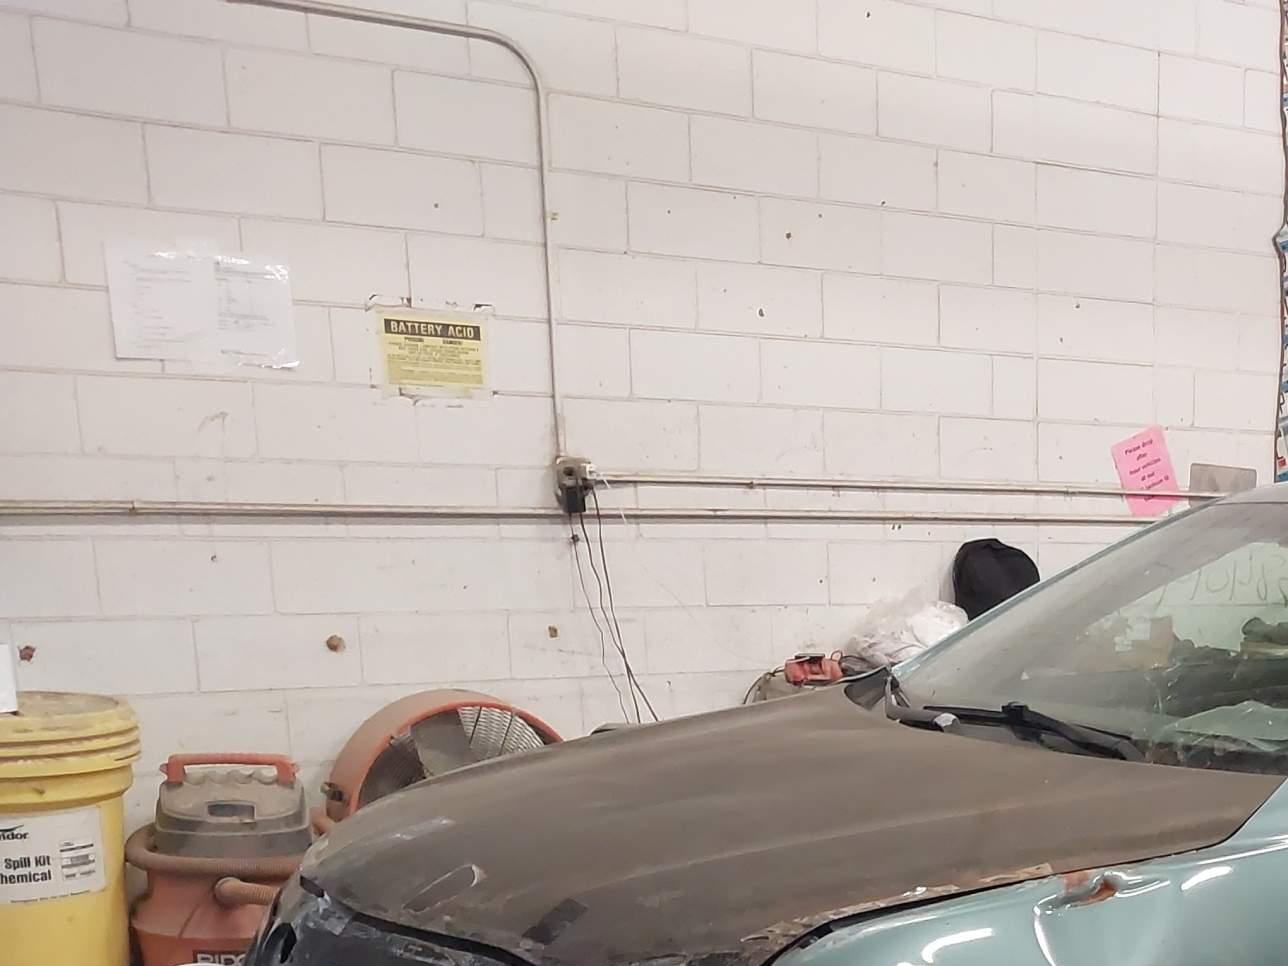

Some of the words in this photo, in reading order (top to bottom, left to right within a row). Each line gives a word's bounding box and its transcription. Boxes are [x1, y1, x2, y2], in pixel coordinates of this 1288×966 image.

[390, 320, 443, 336] BATTERY
[447, 325, 475, 339] ACID
[4, 856, 31, 871] Spill
[34, 855, 51, 867] Kit
